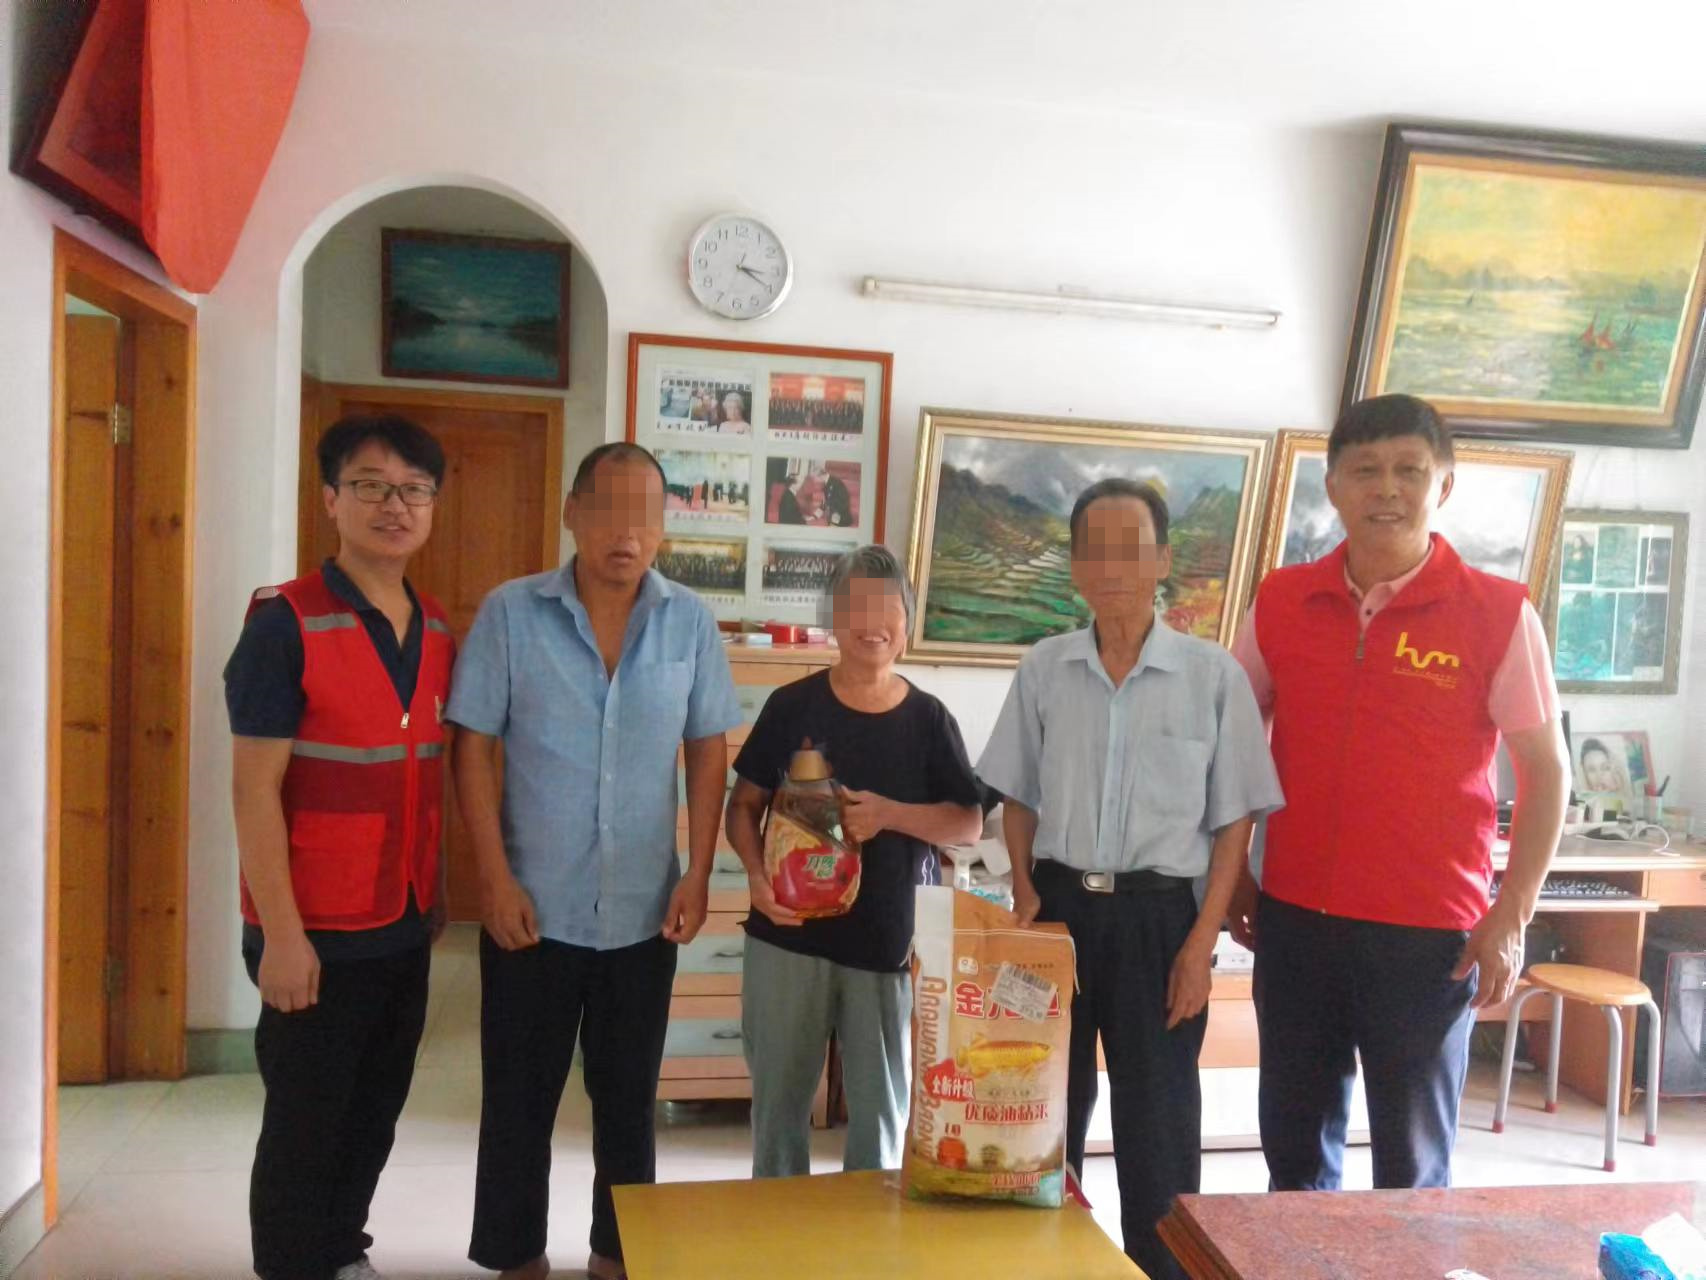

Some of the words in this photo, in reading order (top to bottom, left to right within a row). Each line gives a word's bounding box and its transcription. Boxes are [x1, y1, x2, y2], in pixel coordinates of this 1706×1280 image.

[718, 228, 729, 241] 11
[735, 225, 750, 238] 12
[704, 240, 718, 253] 10
[703, 275, 713, 289] 8
[918, 975, 947, 1077] ARAWAN
